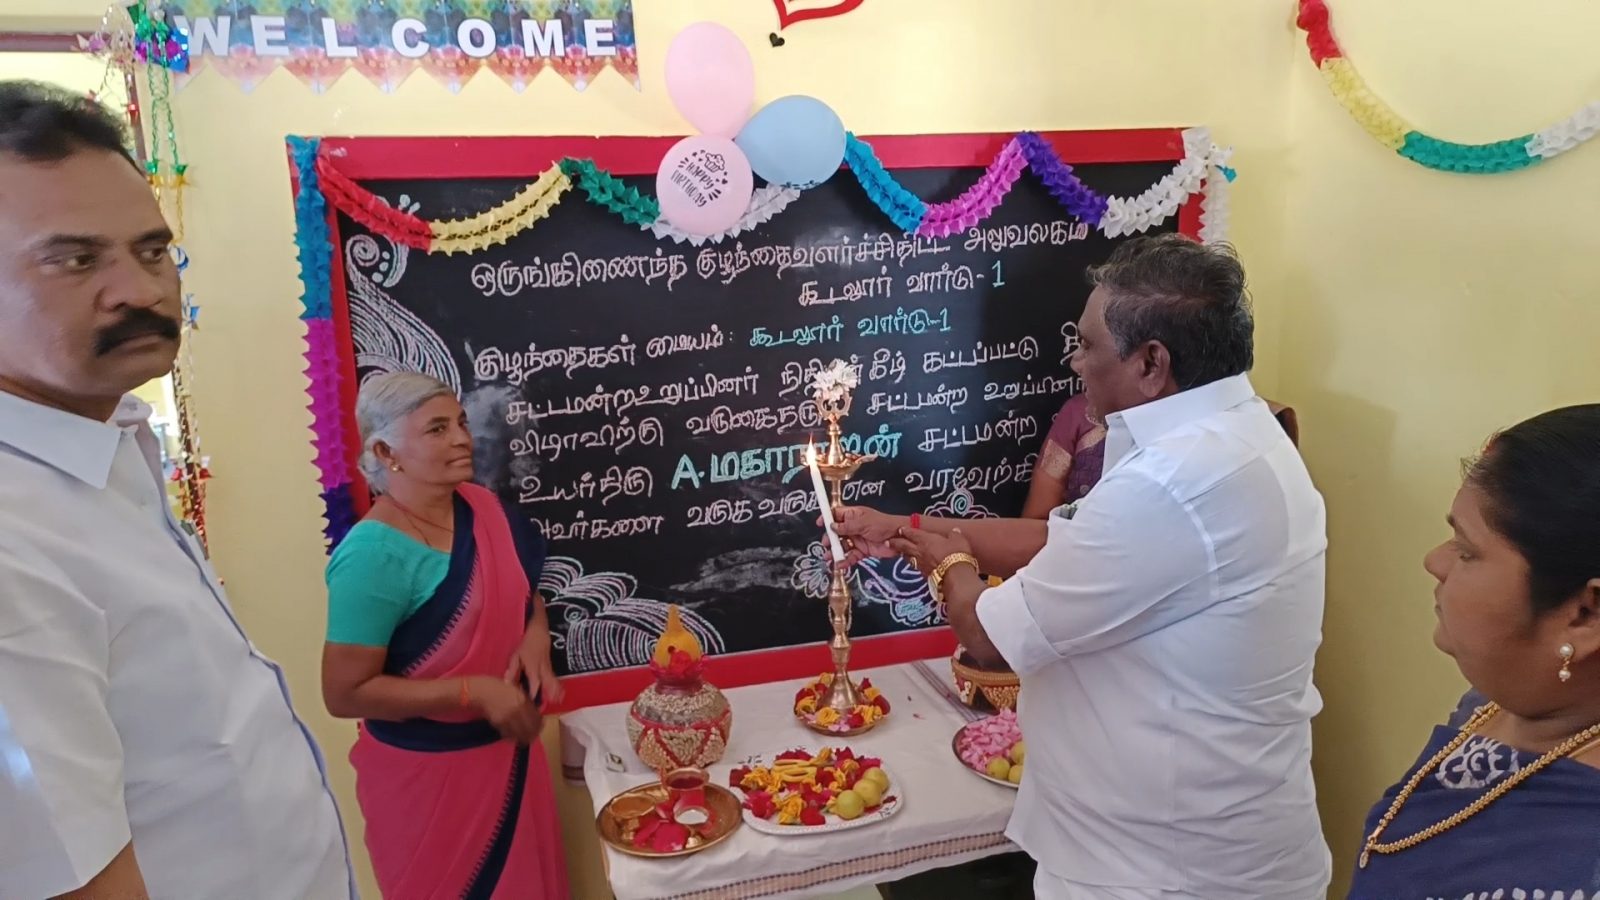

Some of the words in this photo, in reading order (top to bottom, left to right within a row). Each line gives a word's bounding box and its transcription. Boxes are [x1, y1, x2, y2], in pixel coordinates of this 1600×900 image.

[173, 14, 617, 58] WELCOME
[685, 162, 715, 190] HAPPY
[963, 217, 1089, 252] அலுவலகம்
[474, 333, 637, 386] குழந்தைகள்
[749, 315, 845, 347] கூடலூர்
[869, 348, 907, 384] கீழ்
[923, 336, 1039, 374] கட்டப்பட்டு
[509, 416, 665, 462] விழாவிற்கு
[686, 400, 823, 436] வருகைதரு
[866, 383, 969, 416] சட்டமன்ற
[519, 465, 655, 507] உயர்திரு
[917, 410, 1038, 453] சட்டமன்ற
